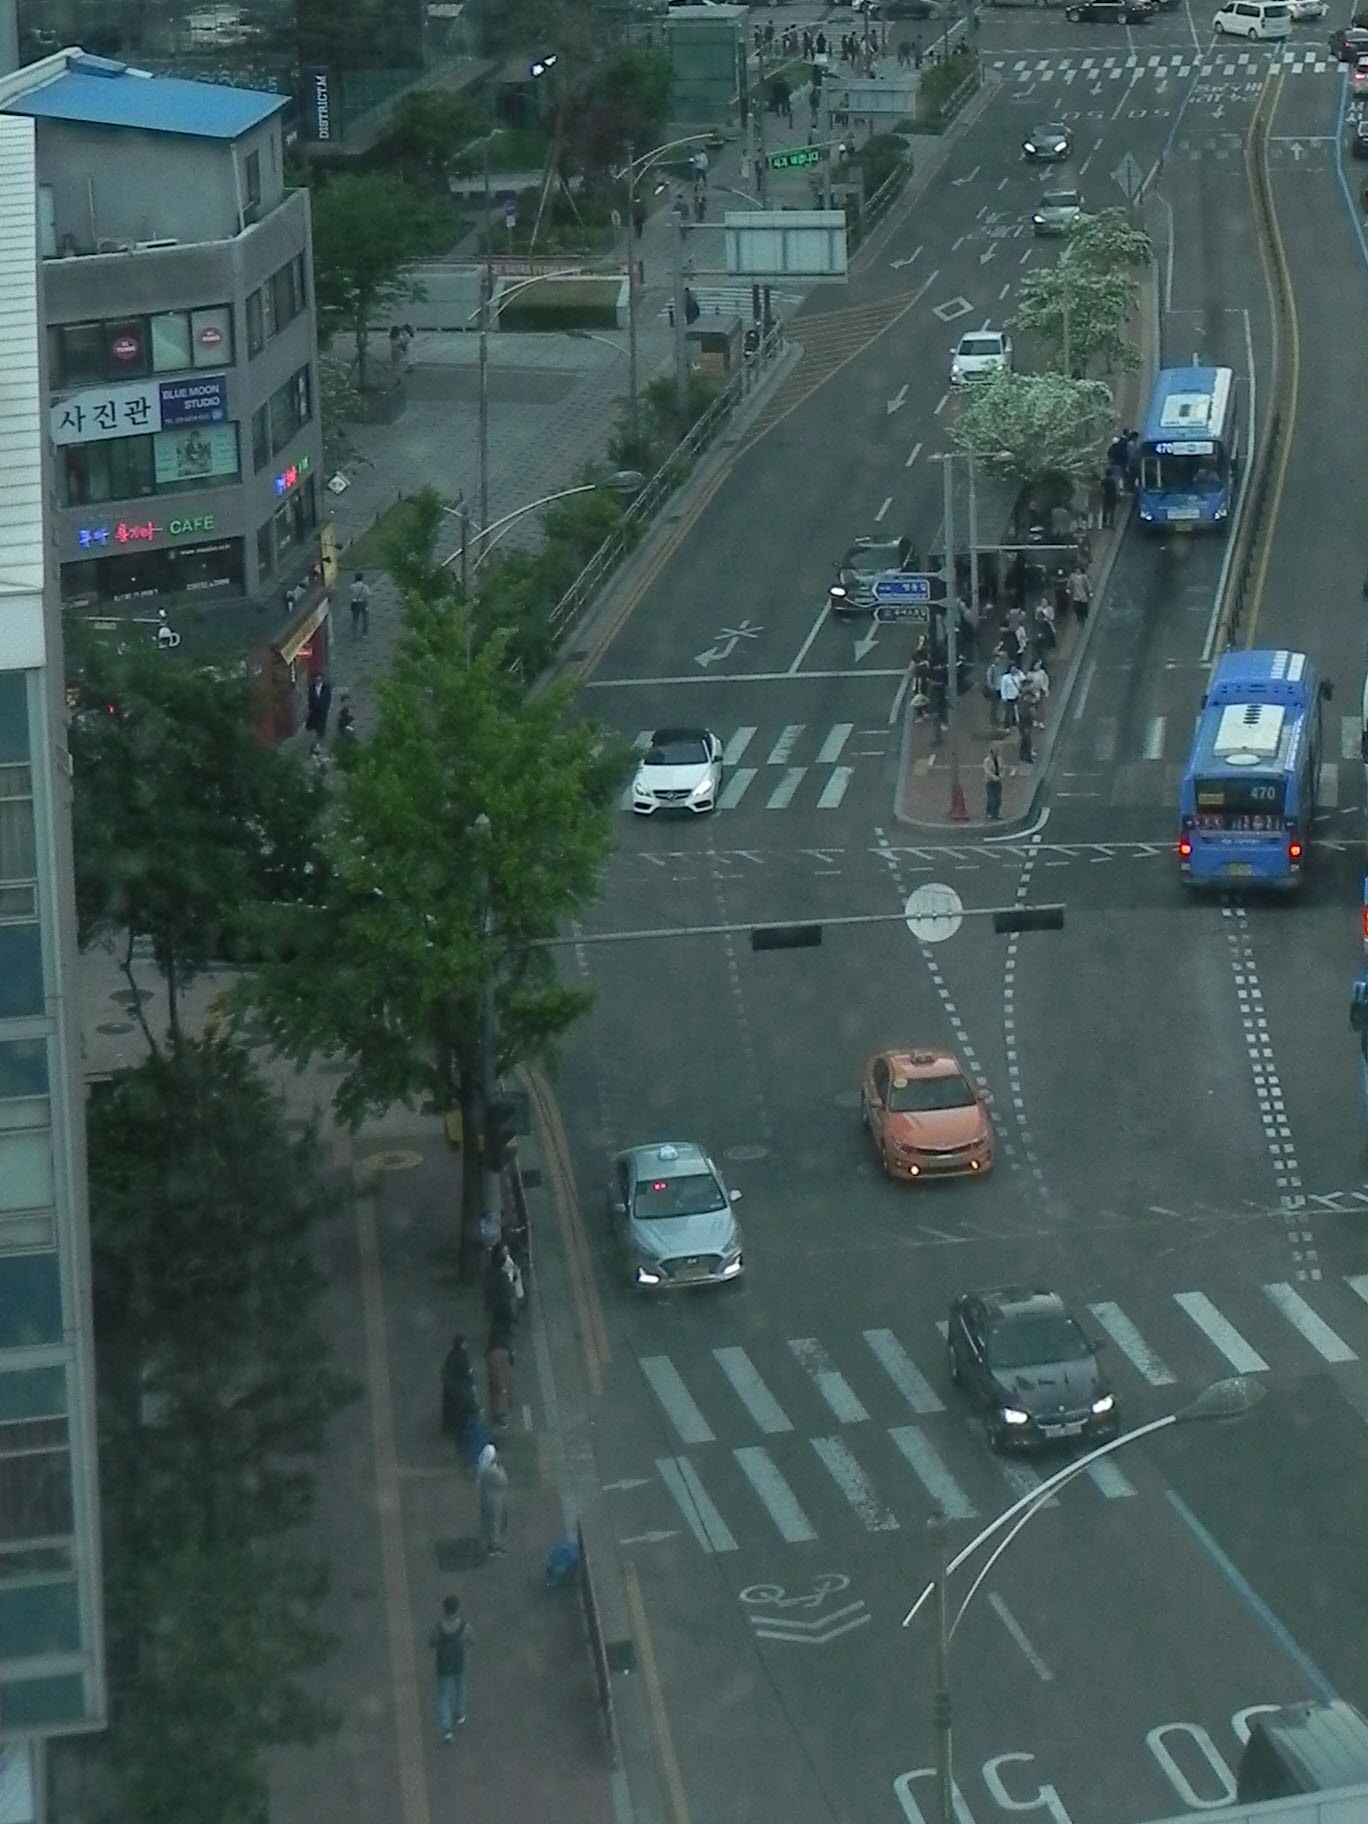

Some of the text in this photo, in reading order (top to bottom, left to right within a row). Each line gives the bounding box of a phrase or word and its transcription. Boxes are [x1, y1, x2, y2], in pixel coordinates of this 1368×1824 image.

[162, 384, 220, 400] BLUE MOON
[184, 396, 220, 410] STUDIO
[59, 396, 152, 433] 사진관
[170, 515, 214, 534] CAFE
[1251, 786, 1276, 800] 470
